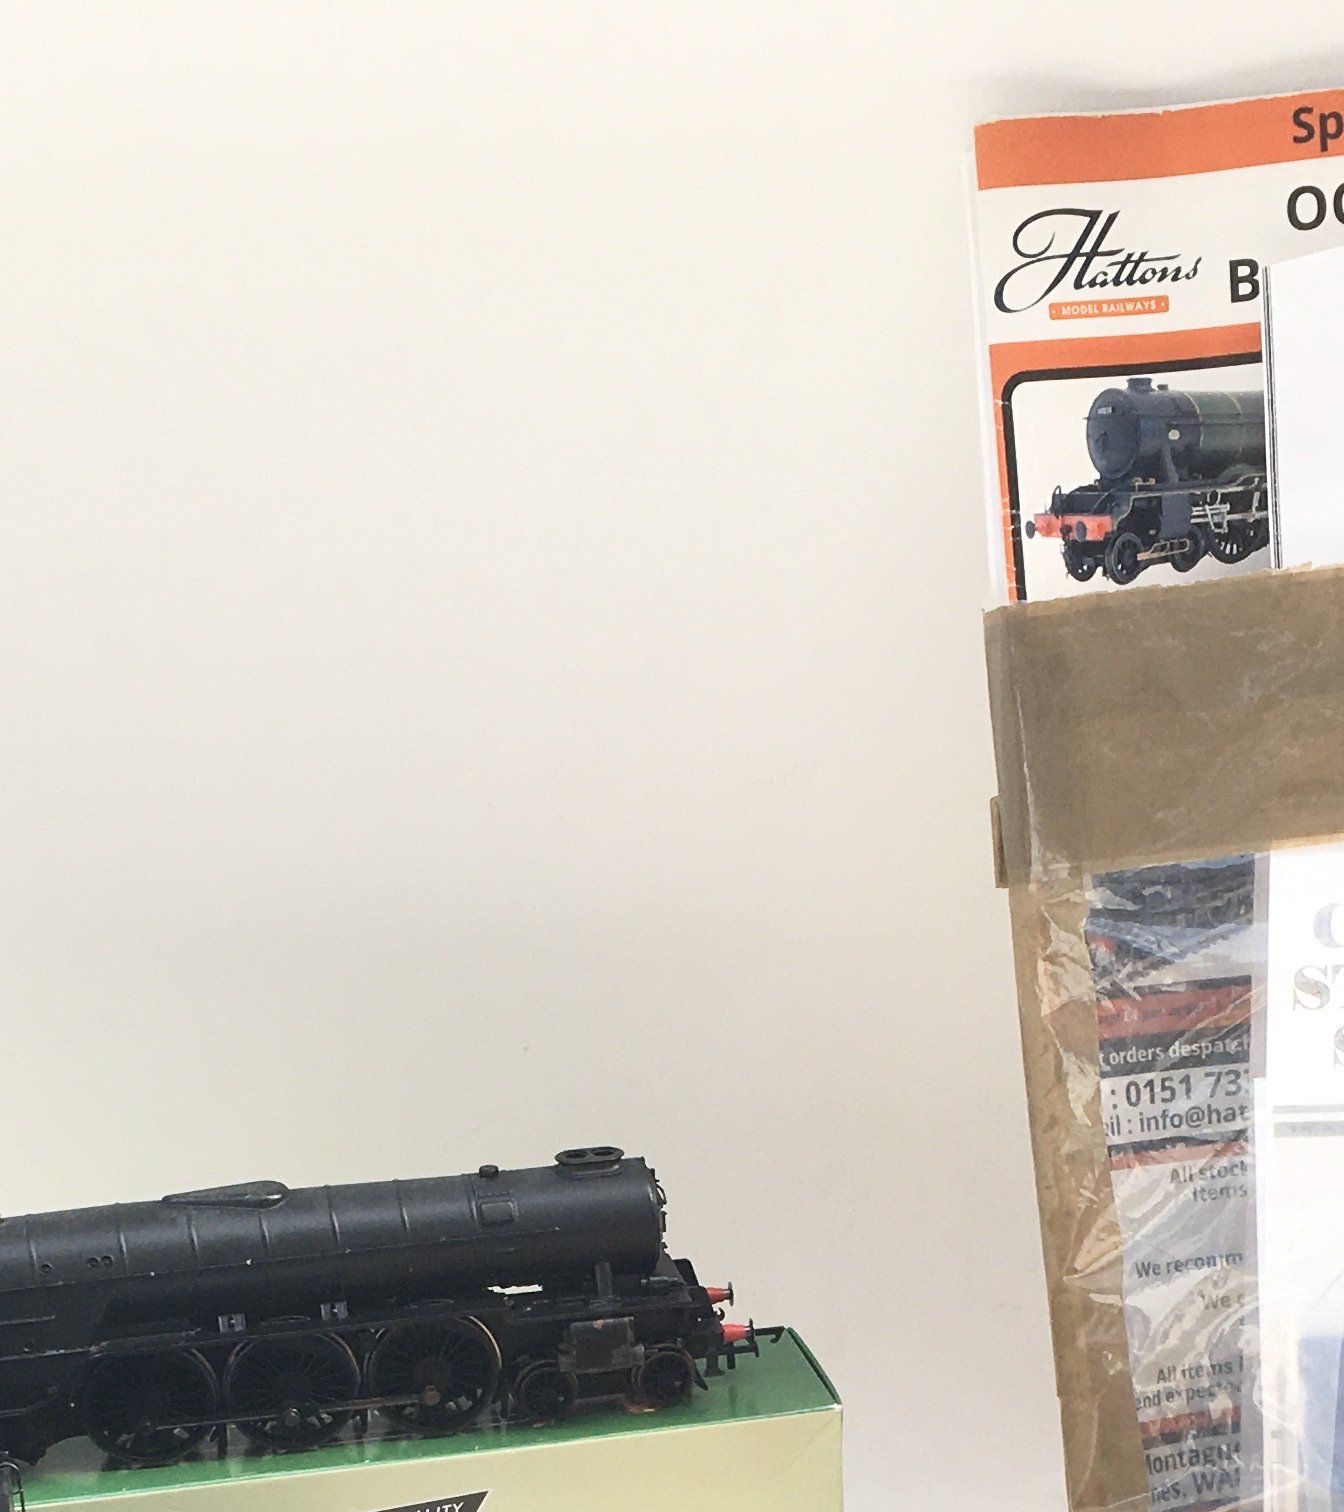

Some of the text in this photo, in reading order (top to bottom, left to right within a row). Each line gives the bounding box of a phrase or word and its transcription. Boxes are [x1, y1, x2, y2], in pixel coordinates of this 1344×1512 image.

[994, 208, 1202, 314] Hattons
[1061, 300, 1157, 316] MODEL RAILWAYS
[1110, 1044, 1165, 1066] orders
[1125, 1074, 1192, 1107] 0151
